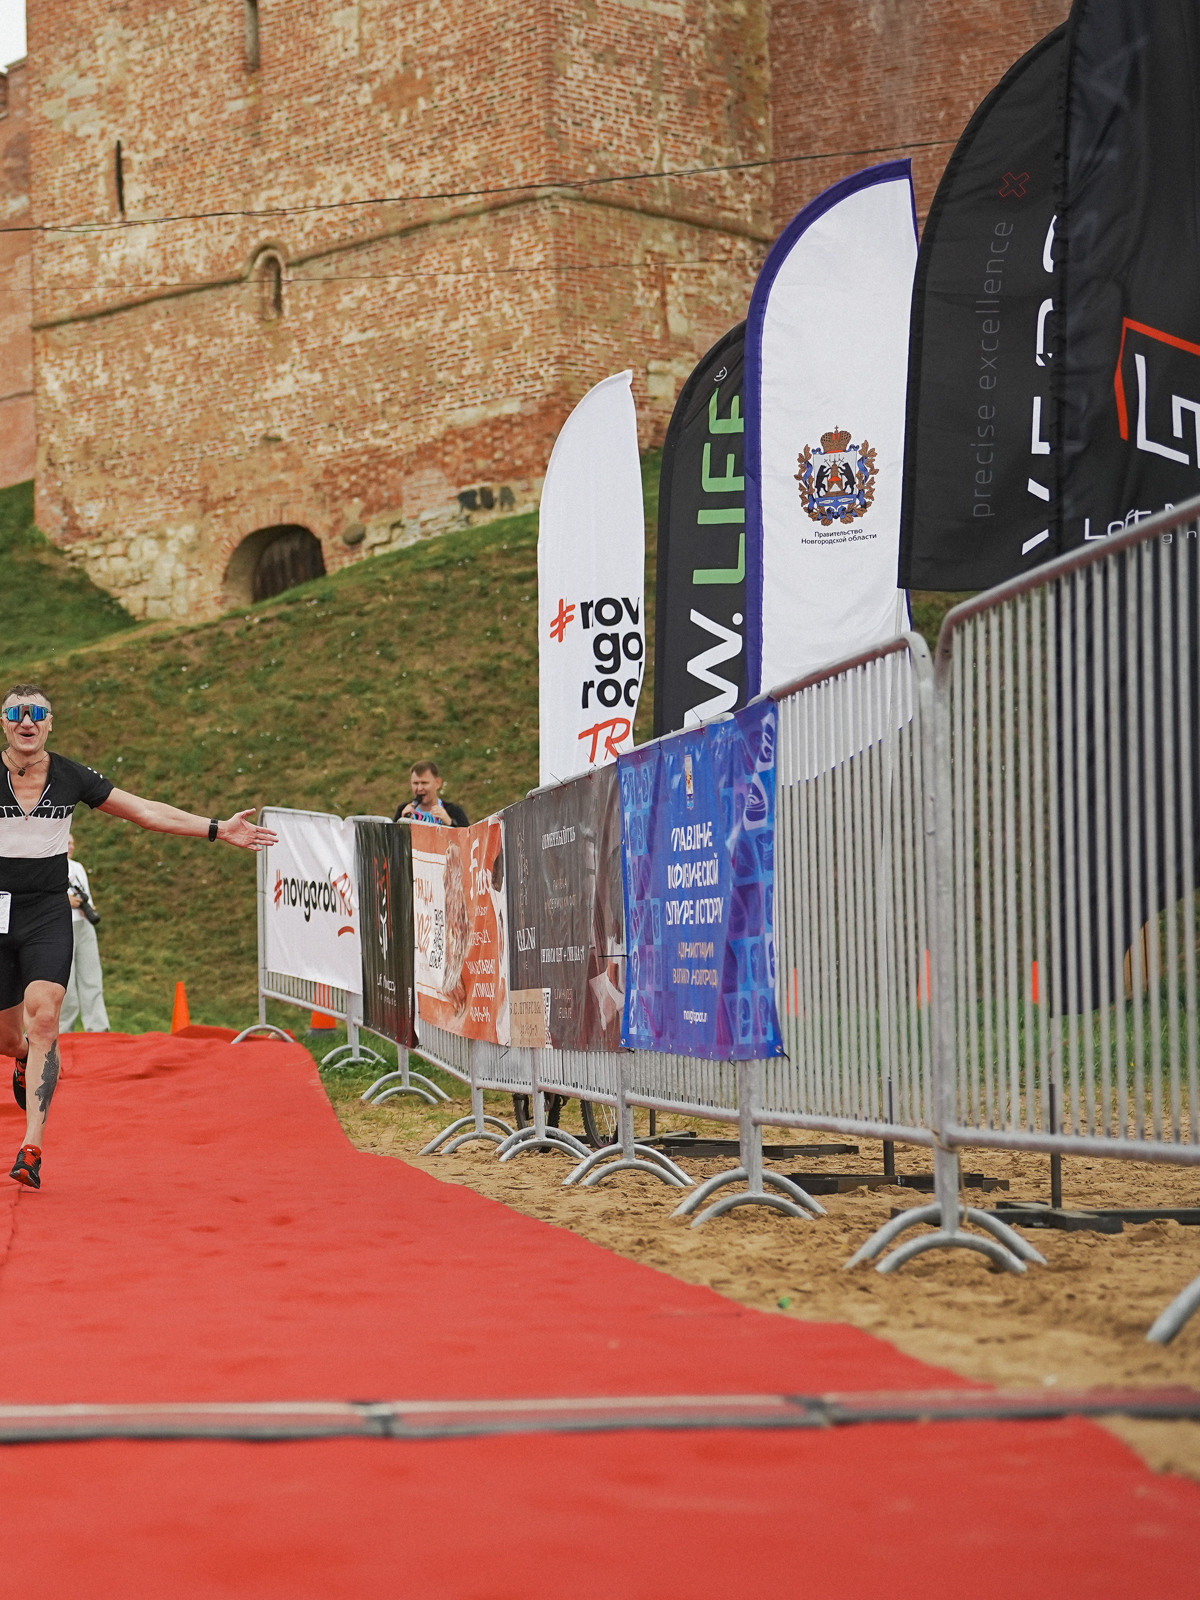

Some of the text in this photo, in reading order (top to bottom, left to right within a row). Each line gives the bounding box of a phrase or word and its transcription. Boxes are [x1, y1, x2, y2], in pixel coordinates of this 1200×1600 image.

[970, 220, 1014, 519] precise excellence
[801, 533, 878, 546] Новгородской области
[814, 528, 864, 538] Правительство
[592, 631, 644, 675] go
